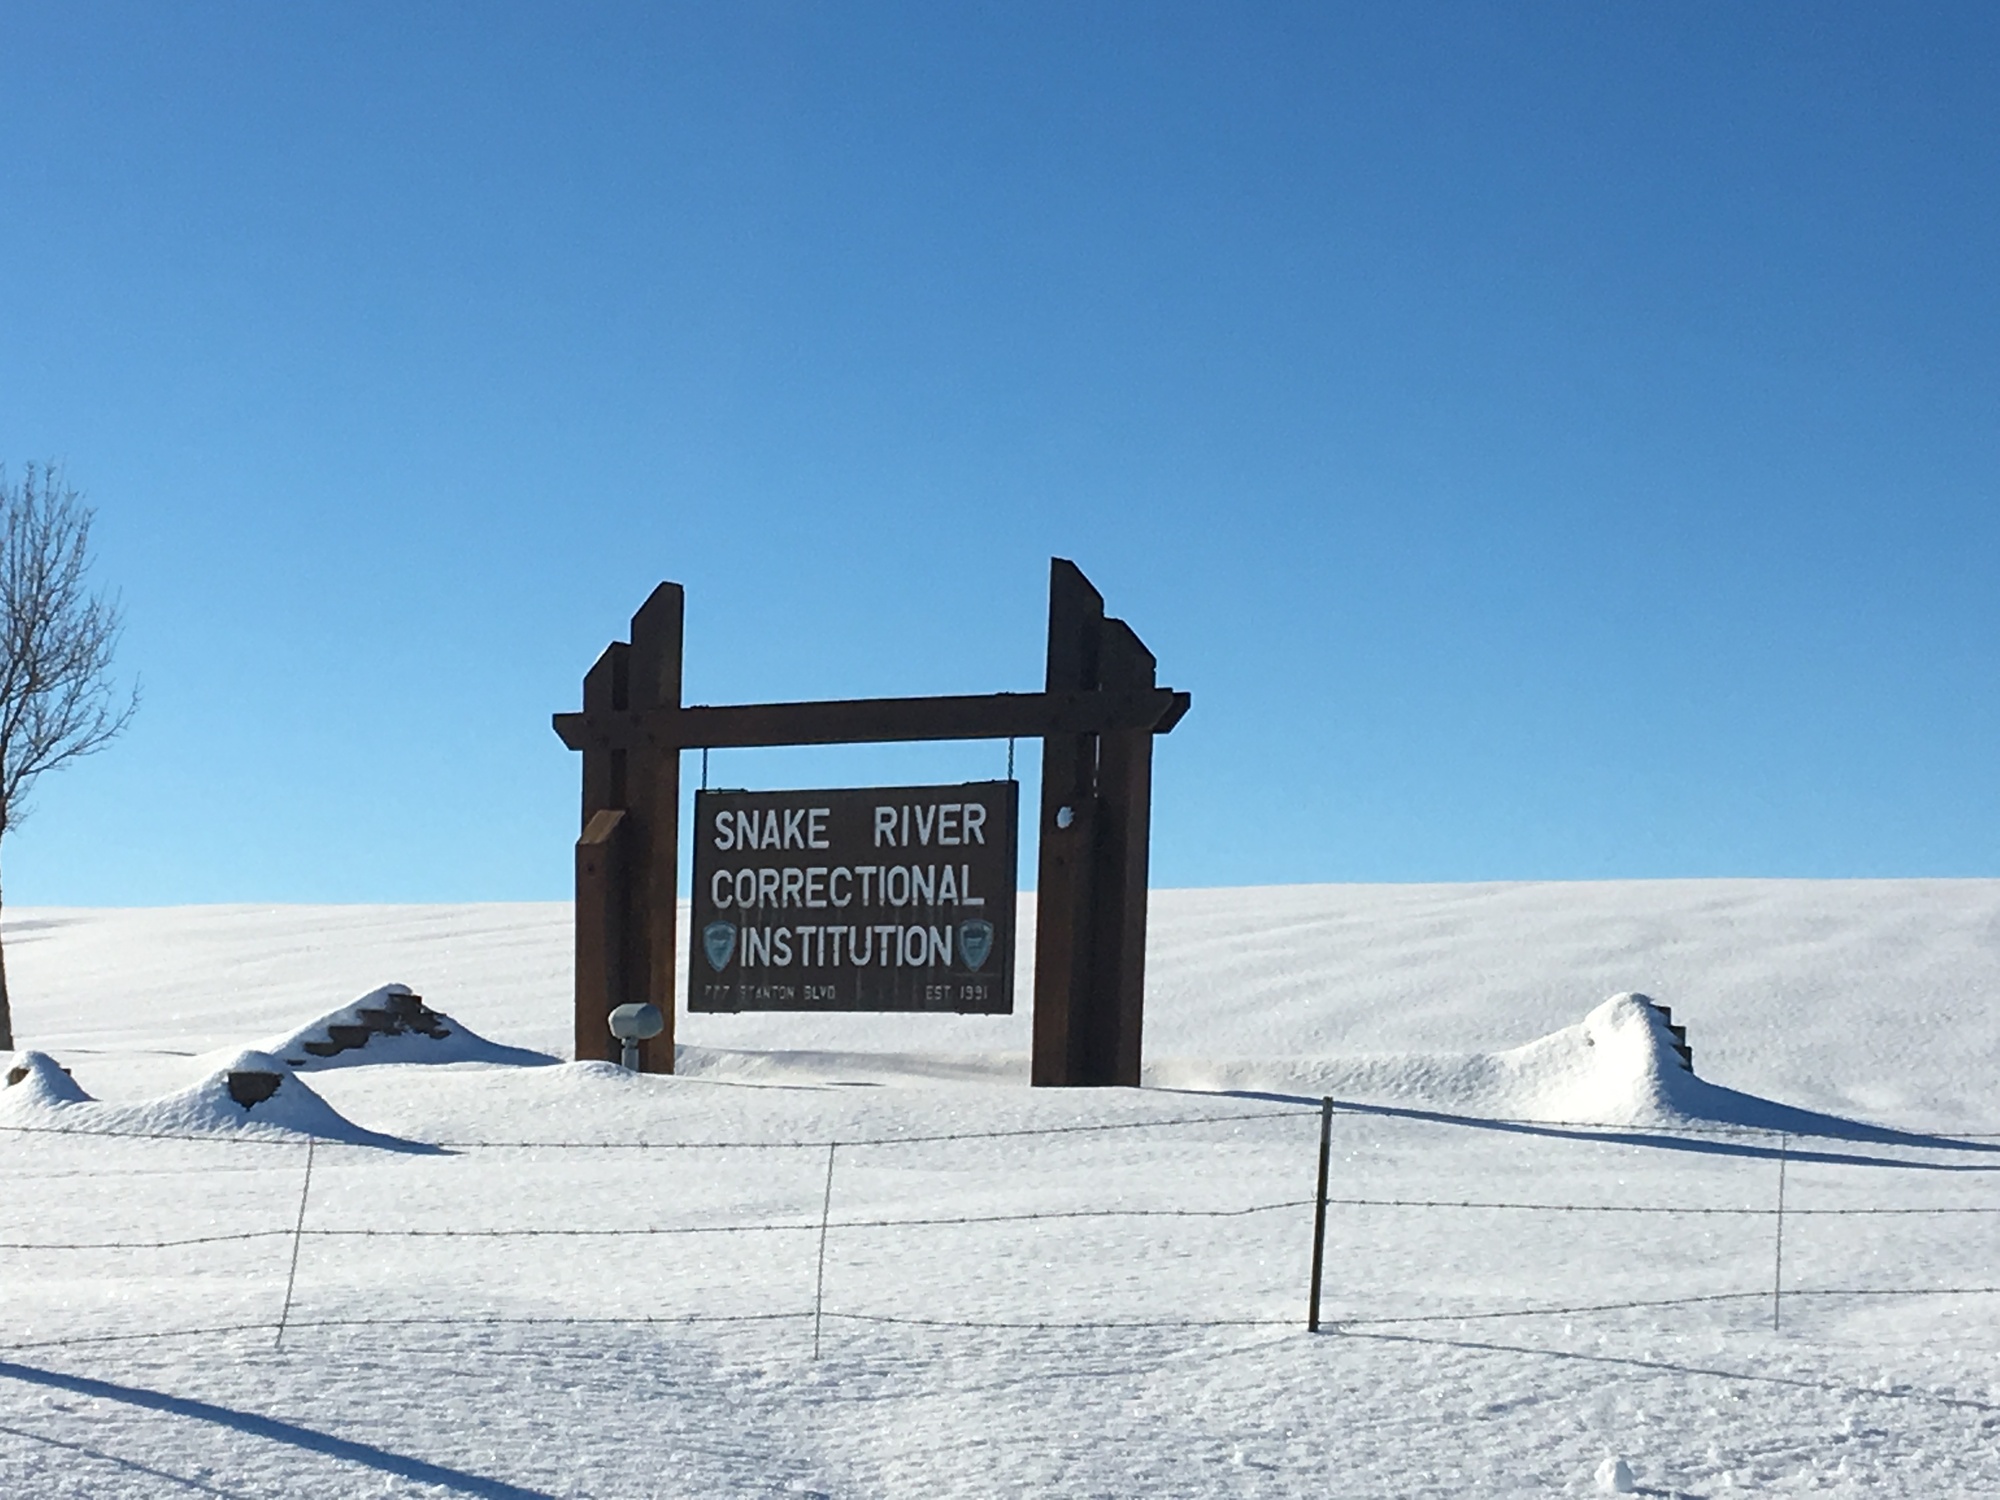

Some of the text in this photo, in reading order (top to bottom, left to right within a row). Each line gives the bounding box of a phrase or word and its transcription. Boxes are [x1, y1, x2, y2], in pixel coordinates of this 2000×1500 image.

[714, 803, 986, 850] SNAKE RIVER
[711, 864, 985, 909] CORRECTIONAL
[740, 925, 952, 967] INSTITUTION
[740, 985, 795, 1000] STANTON
[804, 984, 836, 1000] BLVD
[926, 985, 988, 1000] EST 1991
